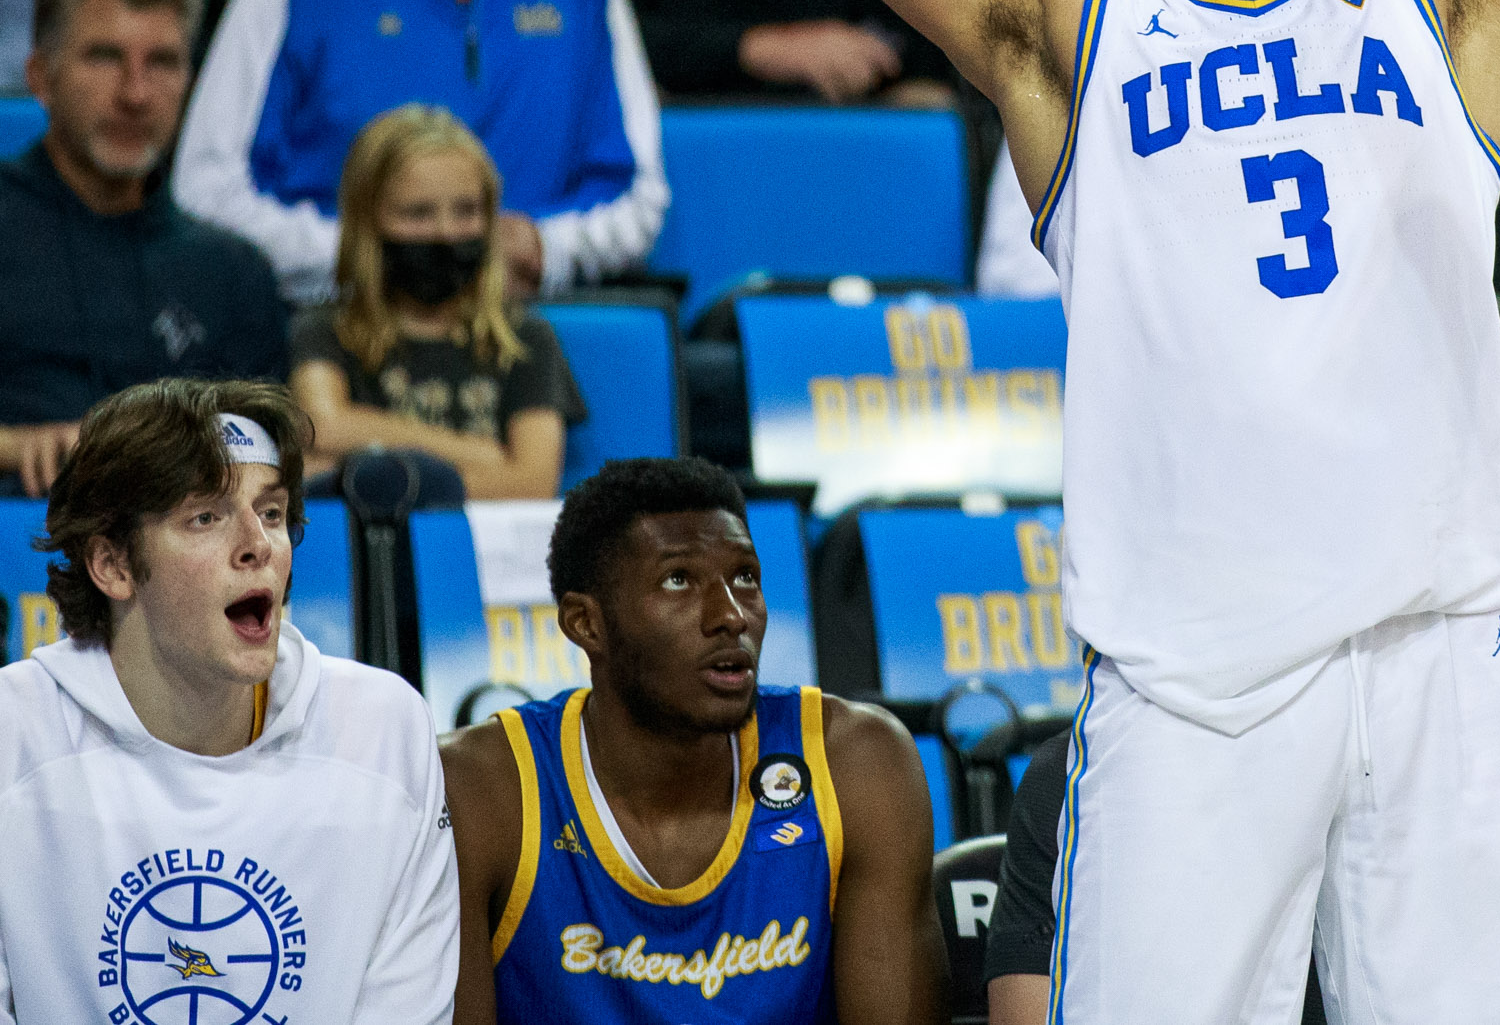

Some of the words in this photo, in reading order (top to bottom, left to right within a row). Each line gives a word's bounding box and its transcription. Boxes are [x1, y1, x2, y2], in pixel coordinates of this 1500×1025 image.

[1121, 35, 1424, 158] UCLA
[1240, 149, 1339, 299] 3
[884, 304, 973, 370] GO
[224, 435, 254, 446] didas
[1015, 520, 1063, 587] G
[98, 849, 225, 987] BAKERSFIELD
[234, 857, 306, 992] RUNNERS
[560, 915, 811, 1000] Bakersfield
